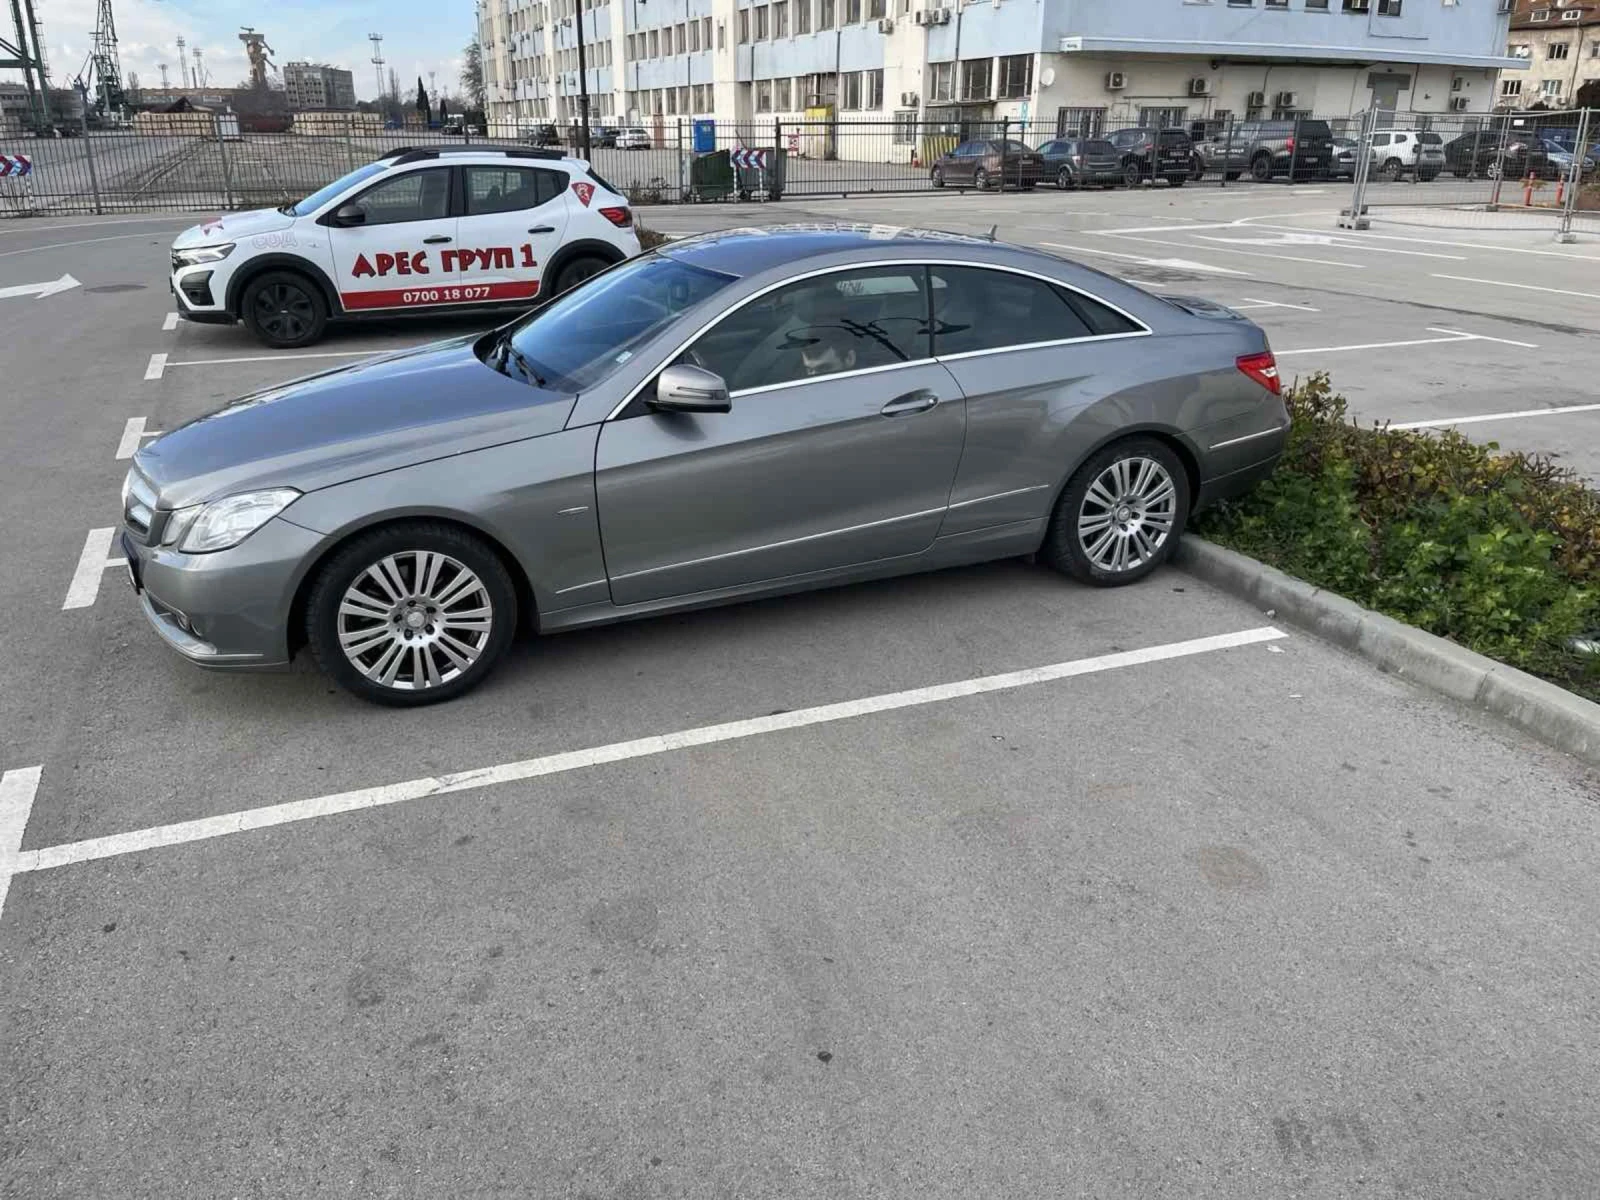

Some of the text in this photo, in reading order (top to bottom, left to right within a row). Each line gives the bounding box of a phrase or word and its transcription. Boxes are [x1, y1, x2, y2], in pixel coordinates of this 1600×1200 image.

[352, 244, 538, 279] АРЕС ГРУП 1
[403, 286, 491, 303] 0700 18 077
